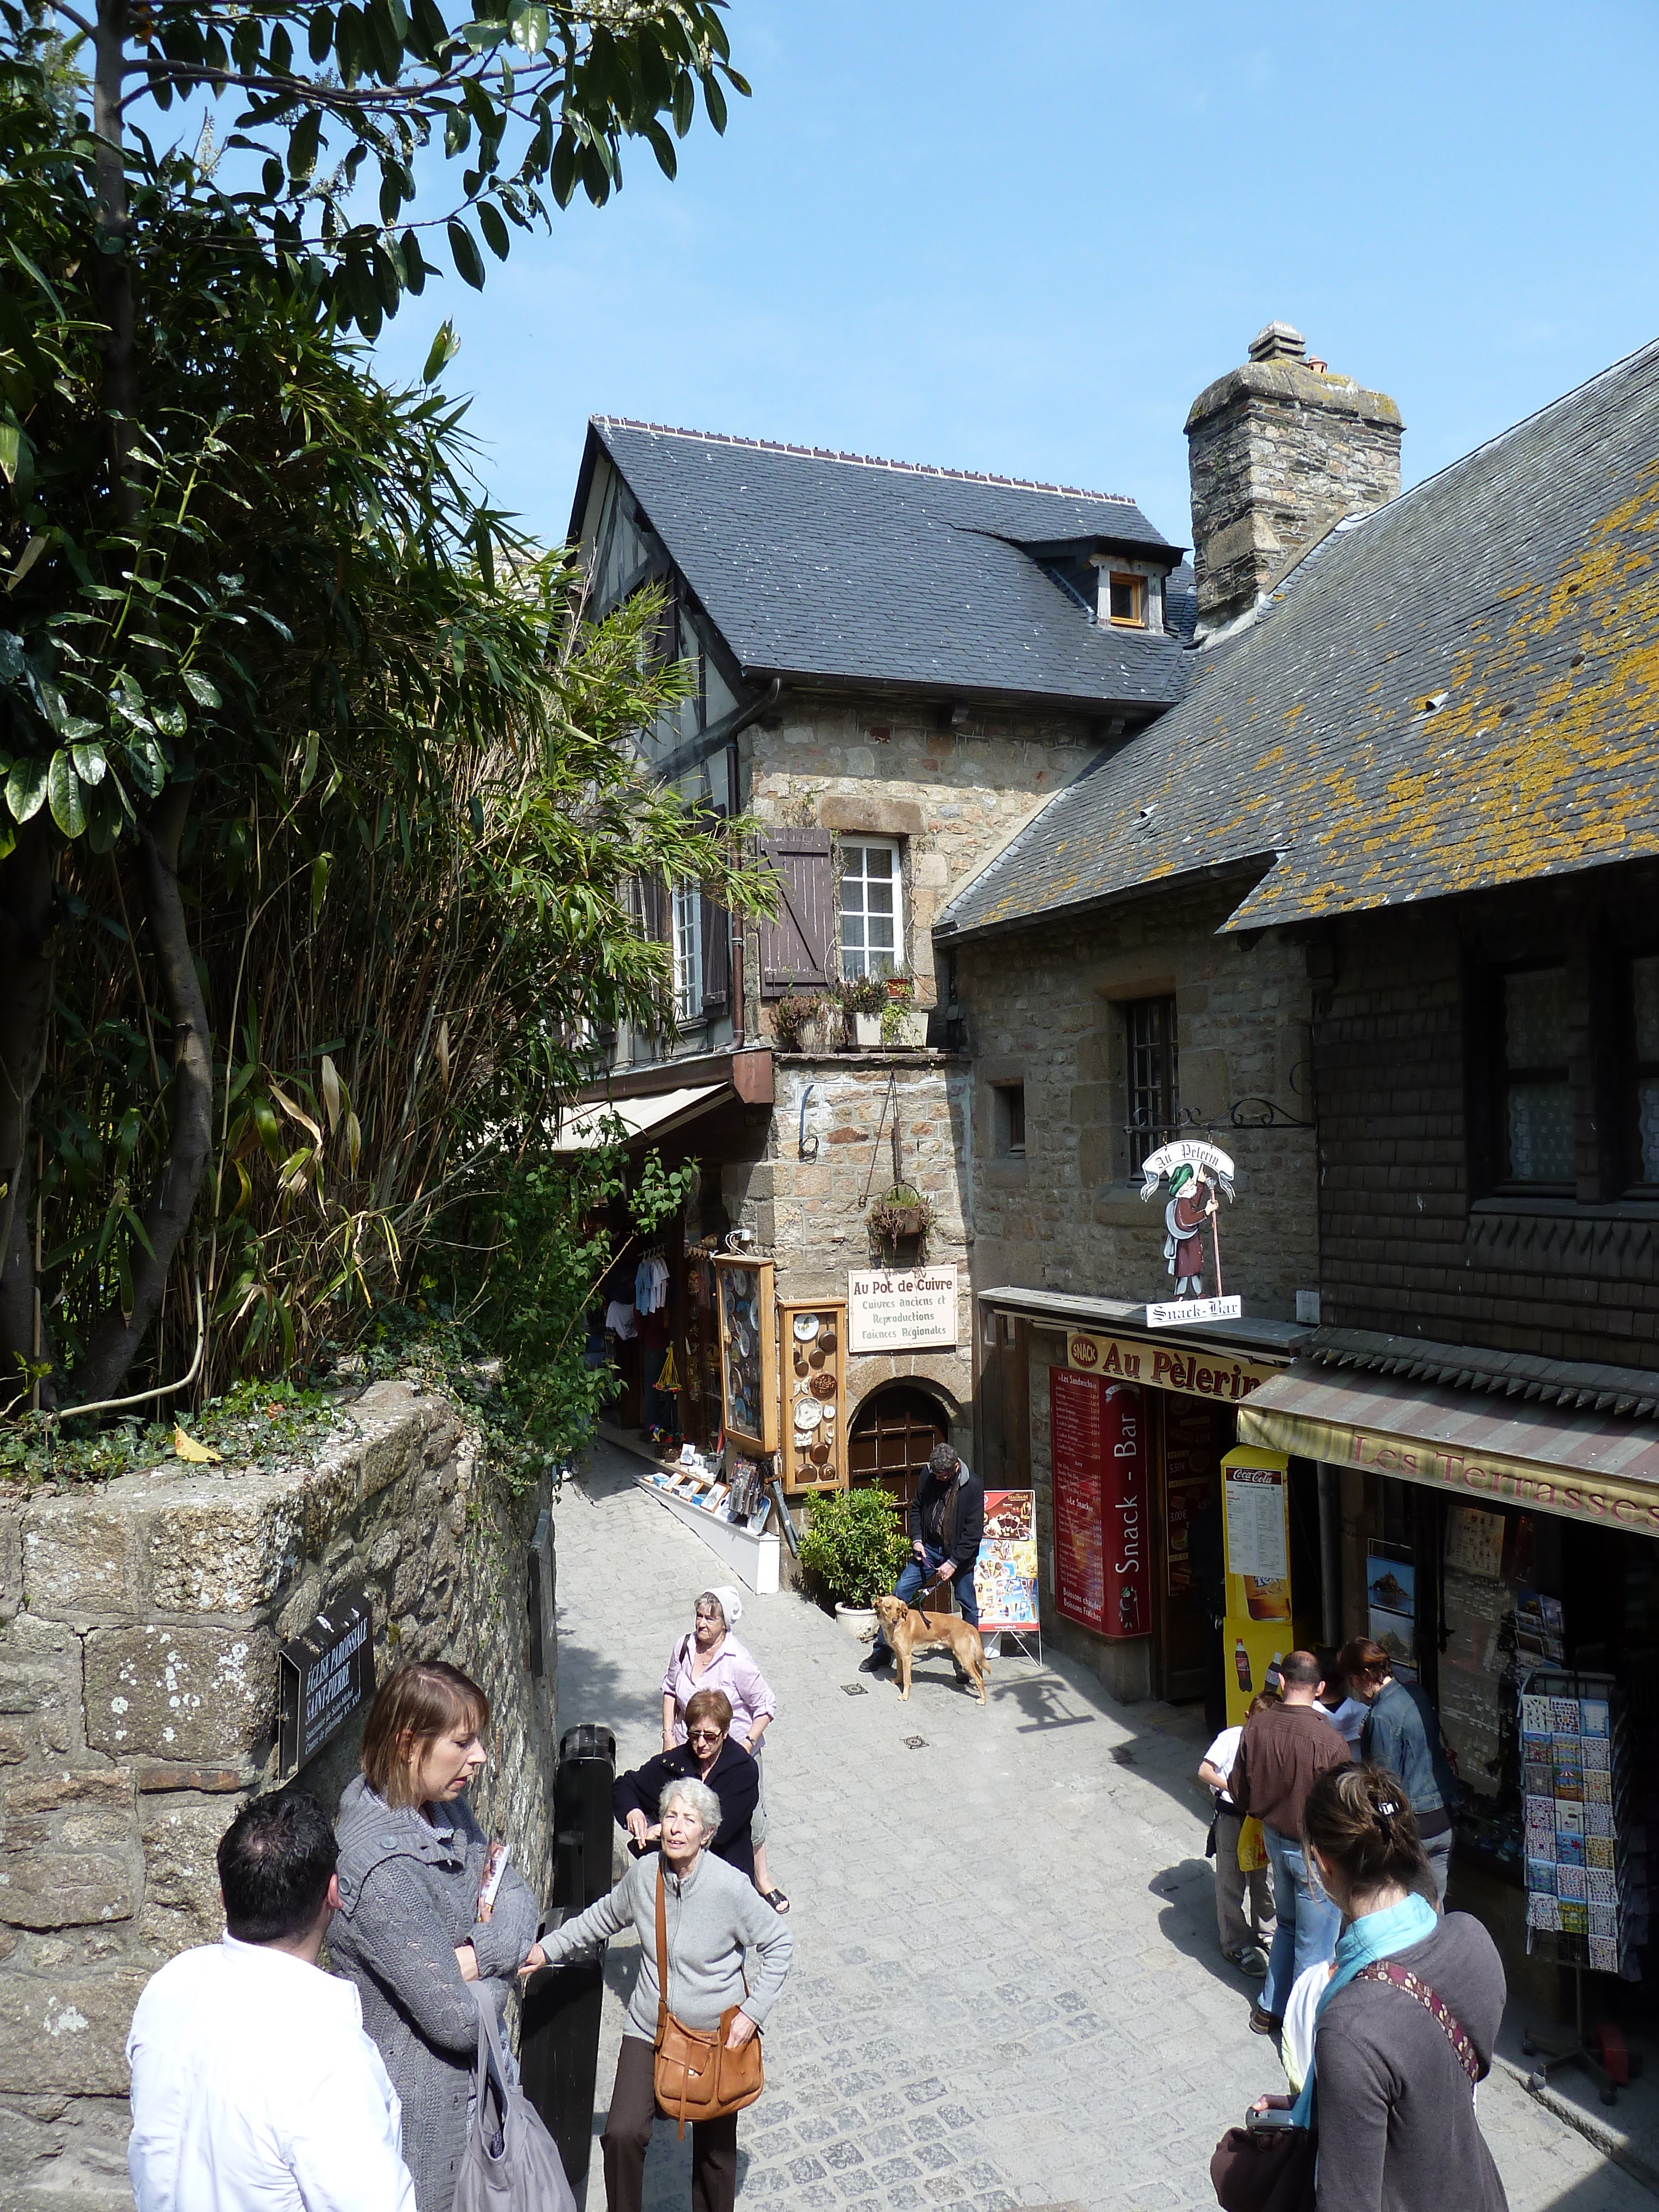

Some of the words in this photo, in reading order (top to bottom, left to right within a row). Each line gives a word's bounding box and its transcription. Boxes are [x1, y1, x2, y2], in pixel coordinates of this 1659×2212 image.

[1155, 1154, 1172, 1169] Au
[1181, 1144, 1219, 1166] Pèlerin
[854, 1282, 869, 1295] Au
[873, 1281, 894, 1294] Pot
[898, 1280, 914, 1292] de
[917, 1277, 953, 1291] Cuivre
[862, 1299, 895, 1310] Cuivres
[900, 1296, 933, 1308] anciens
[938, 1295, 946, 1305] et
[1151, 1300, 1238, 1323] Snack-Bar
[873, 1311, 935, 1326] Reproductions
[1073, 1343, 1096, 1362] SNACK
[1102, 1343, 1140, 1379] Au
[1150, 1350, 1262, 1400] Pèlerin
[1114, 1413, 1137, 1457] Bar
[1353, 1436, 1417, 1475] Les
[1233, 1468, 1274, 1484] Coca-Cola
[1115, 1494, 1139, 1574] Snack
[1063, 1587, 1082, 1603] Boissons
[1083, 1597, 1101, 1611] chaudes
[1064, 1598, 1082, 1613] Boissons
[306, 1653, 330, 1697] ÉGLISE
[330, 1618, 367, 1673] PAROISSIALE
[306, 1661, 351, 1725] SAINT-PIERRE
